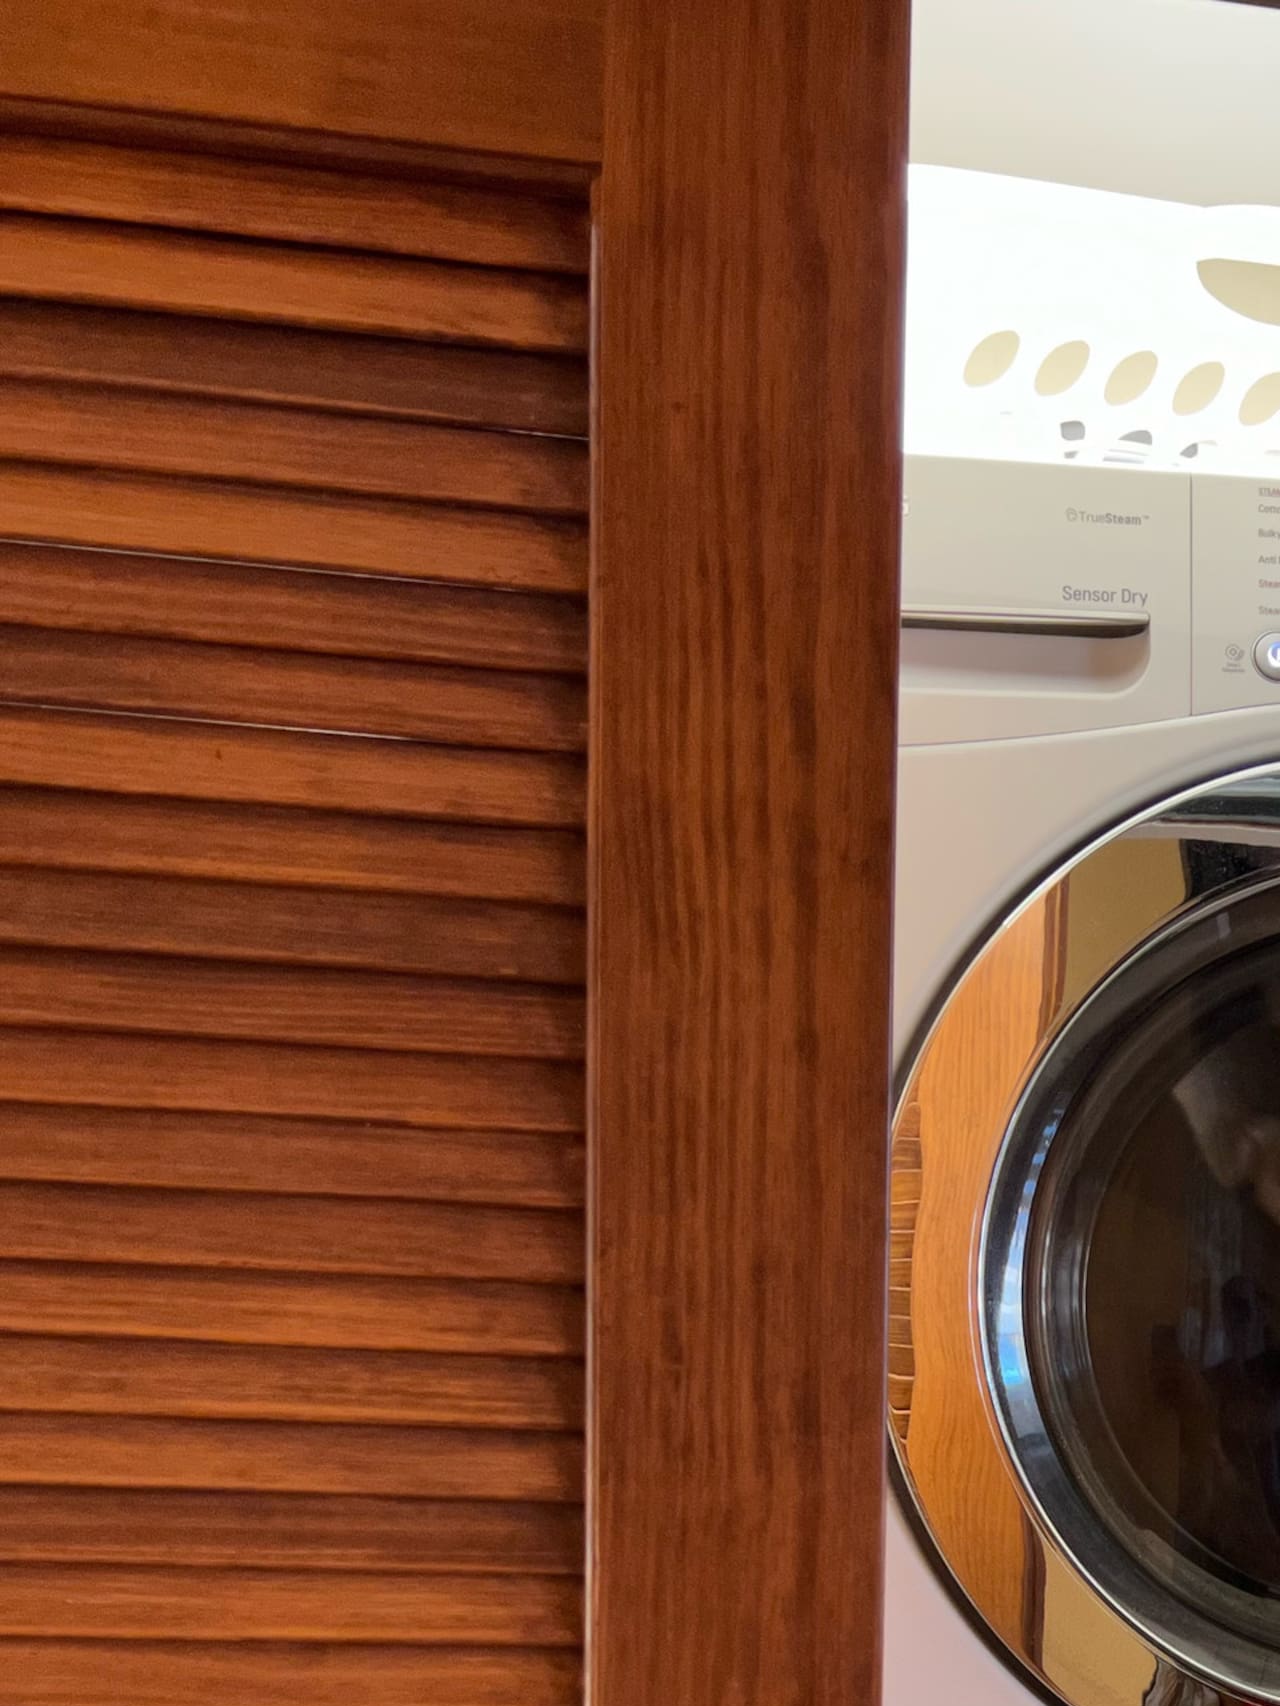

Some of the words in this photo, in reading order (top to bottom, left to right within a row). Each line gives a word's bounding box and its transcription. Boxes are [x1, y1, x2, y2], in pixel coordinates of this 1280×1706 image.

[1258, 554, 1277, 565] Anti
[1061, 585, 1117, 604] Sensor
[1121, 588, 1149, 607] Dry
